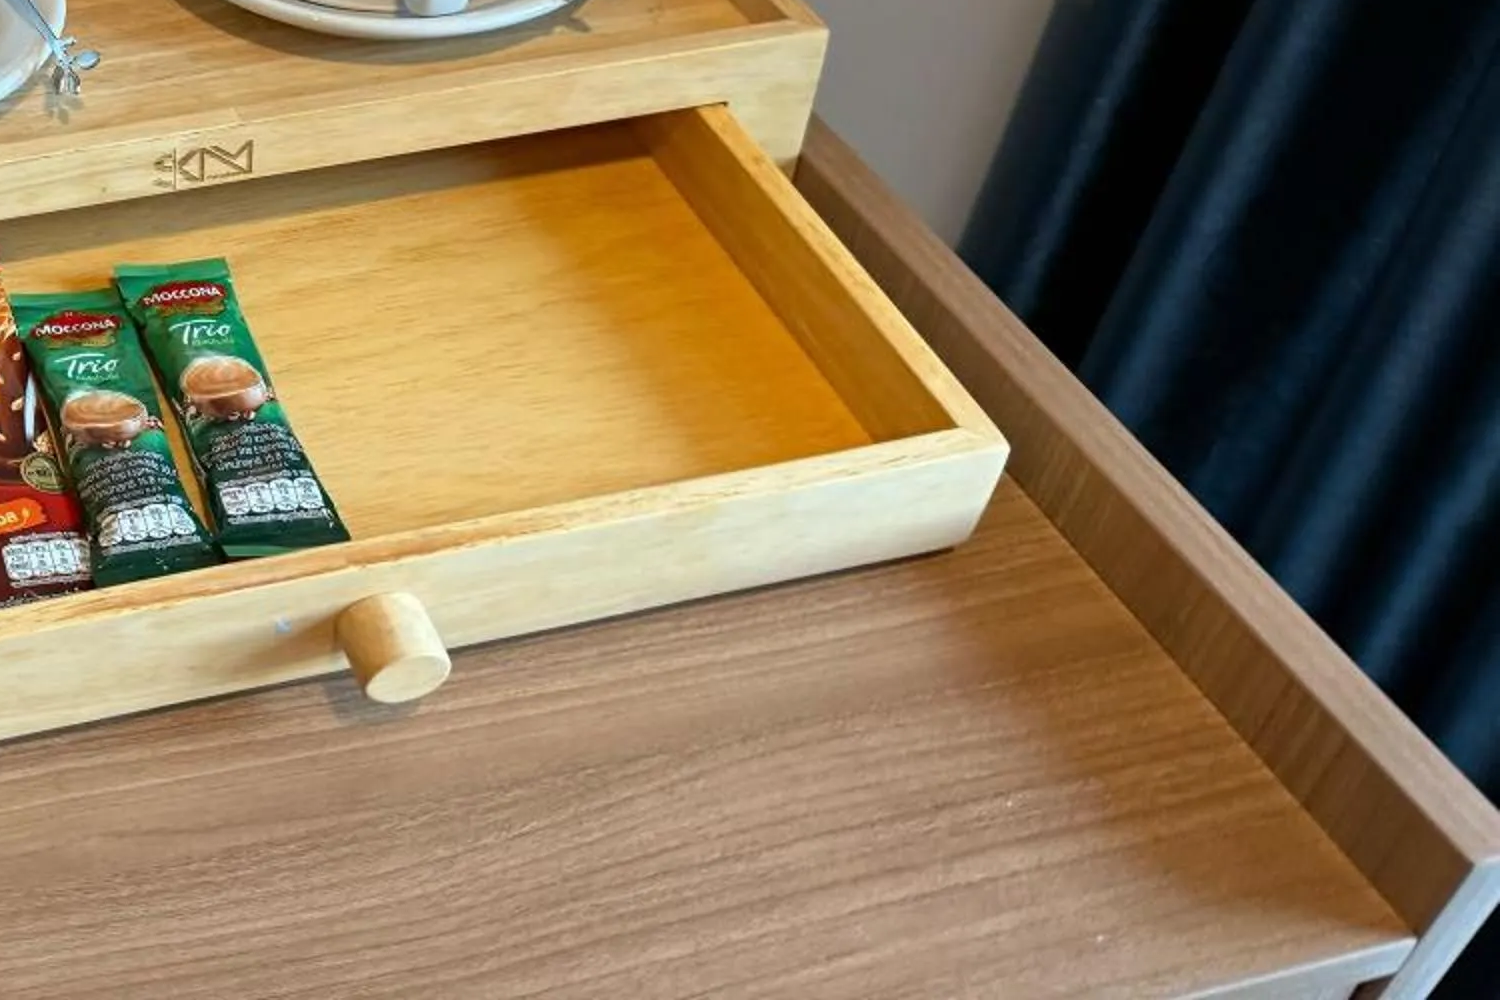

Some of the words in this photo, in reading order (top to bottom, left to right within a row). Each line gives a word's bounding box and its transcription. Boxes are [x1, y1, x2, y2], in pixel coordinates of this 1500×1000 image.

[142, 286, 224, 305] MOCCONA
[35, 318, 117, 337] MOCCONA
[168, 319, 231, 345] Trio
[54, 353, 119, 378] Trio
